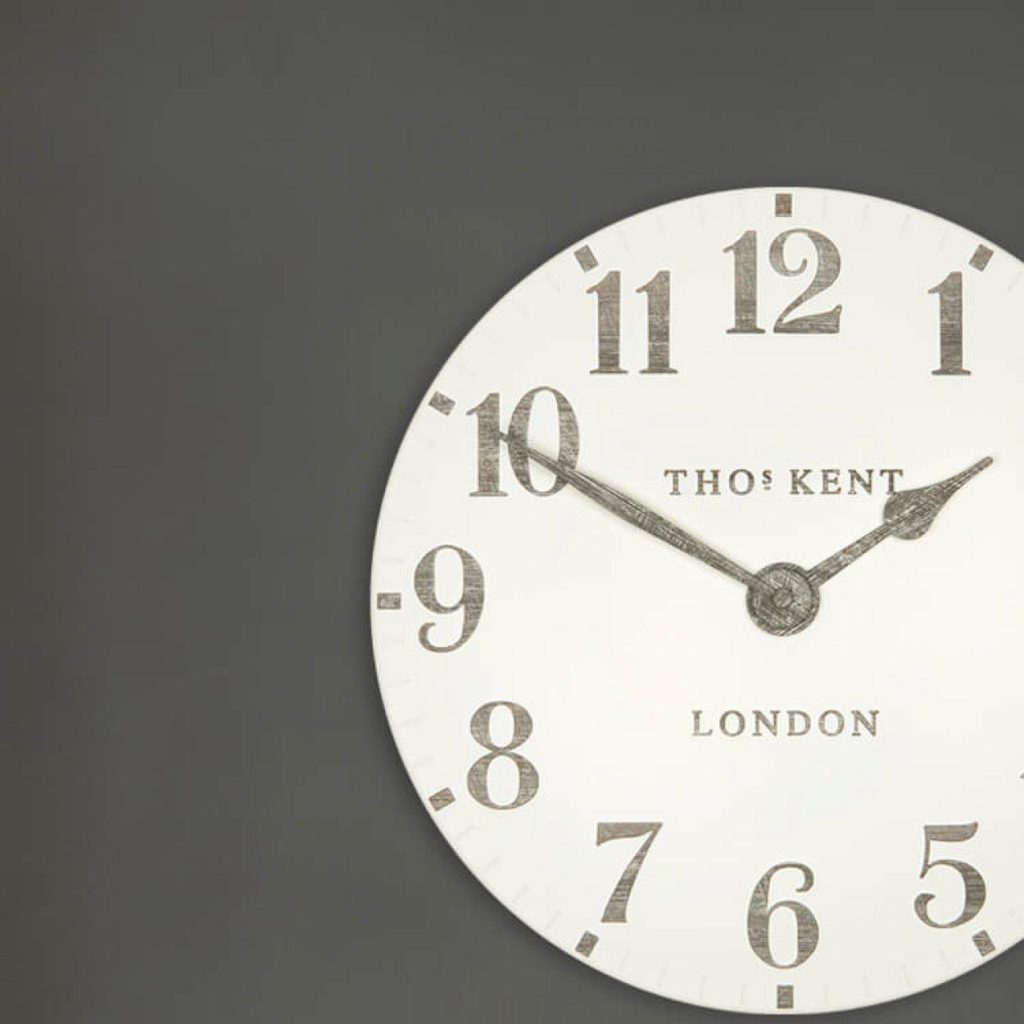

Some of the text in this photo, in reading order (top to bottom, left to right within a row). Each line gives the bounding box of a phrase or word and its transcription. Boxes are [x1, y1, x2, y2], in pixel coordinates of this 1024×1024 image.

[585, 270, 679, 375] 11
[723, 228, 843, 335] 12
[927, 271, 972, 376] 1
[467, 386, 581, 497] 10
[789, 468, 905, 496] KENT
[413, 544, 485, 653] 9
[468, 701, 539, 810] 8
[692, 709, 880, 737] LONDON
[596, 821, 662, 923] 7
[747, 862, 820, 969] 6
[914, 822, 987, 930] 5
